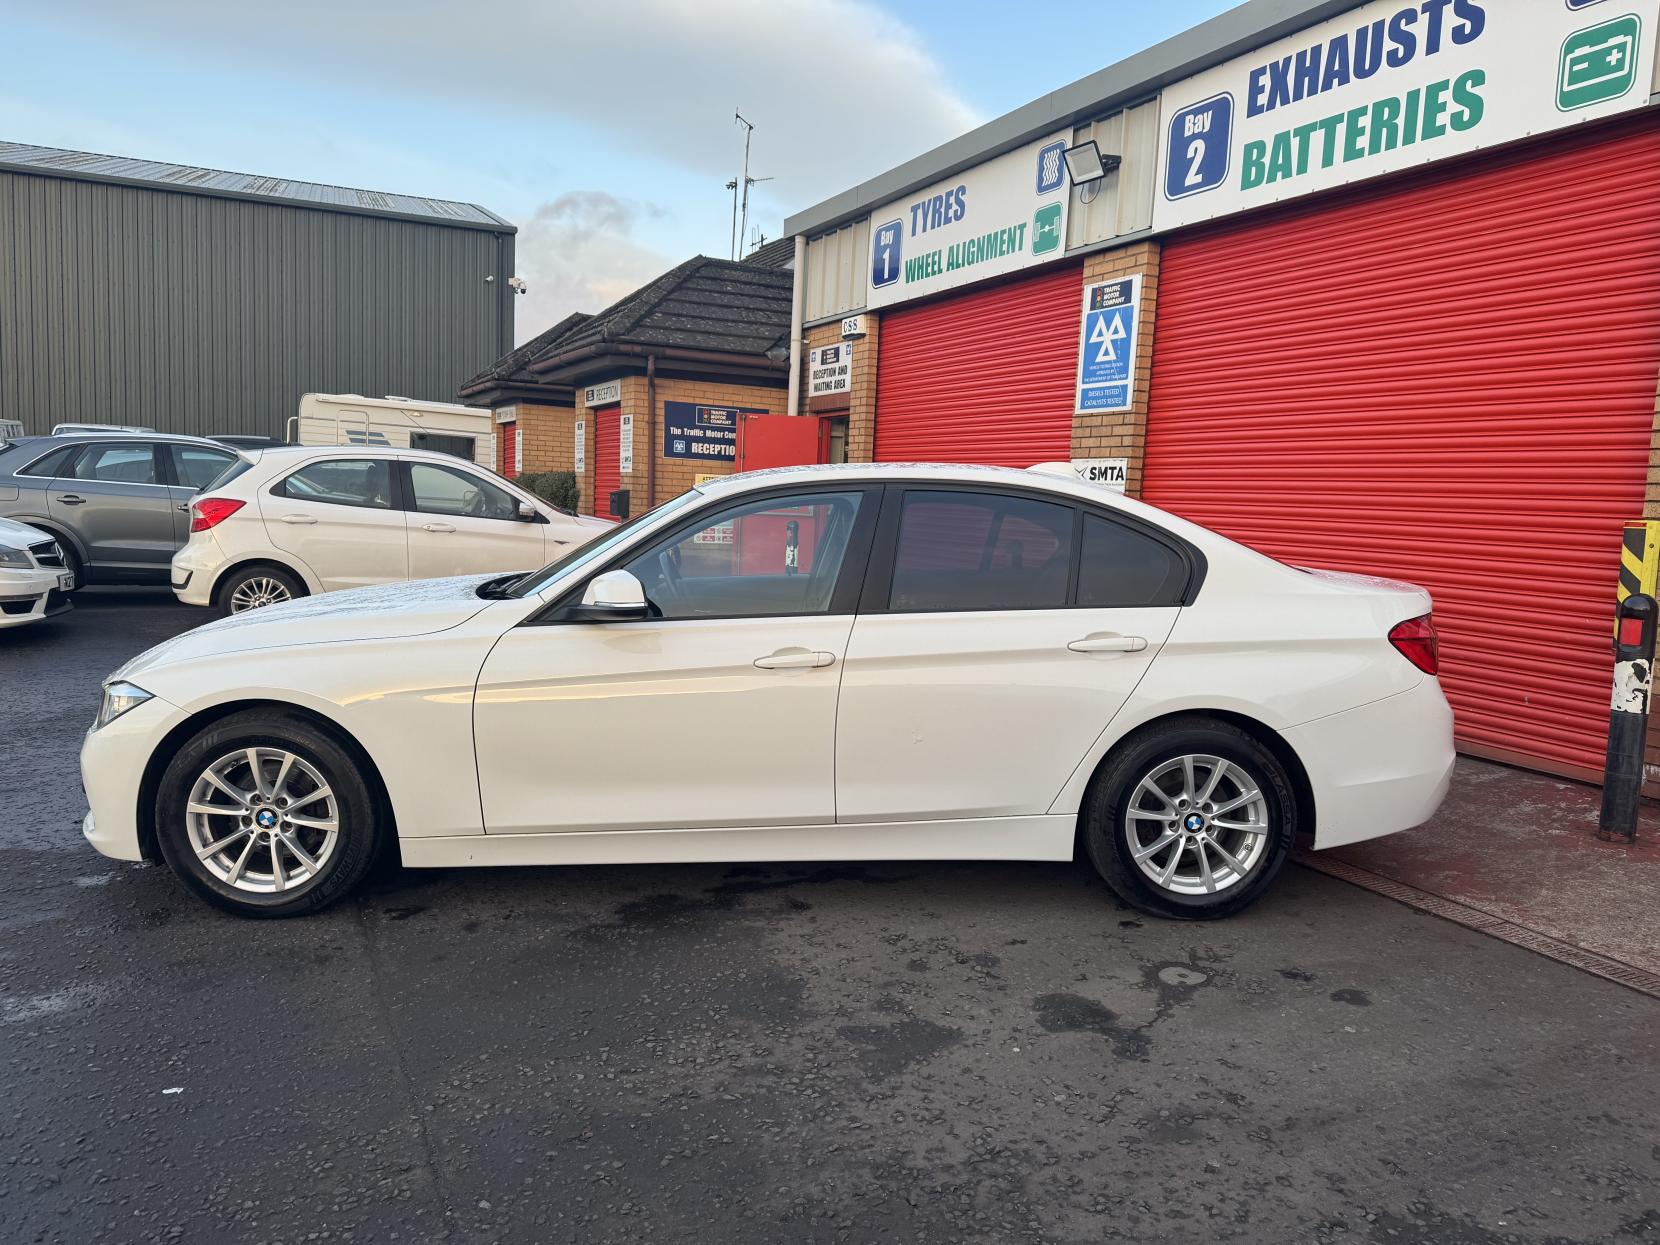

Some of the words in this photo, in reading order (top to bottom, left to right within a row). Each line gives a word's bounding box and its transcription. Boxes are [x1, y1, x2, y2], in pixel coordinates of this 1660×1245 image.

[1247, 0, 1486, 118] EXHAUSTS
[1184, 112, 1212, 137] Bay
[1240, 68, 1486, 191] BATTERIES
[1184, 139, 1205, 188] 2
[910, 184, 967, 237] TYRES
[880, 229, 894, 246] Bay
[905, 249, 943, 284] WHEEL
[946, 222, 1027, 272] ALIGNMENT
[882, 248, 890, 279] 1
[1104, 285, 1120, 293] TRAFFIC
[1103, 297, 1125, 306] COMPANY
[813, 367, 837, 379] RECEPTION
[838, 365, 848, 376] AND
[813, 381, 833, 392] WAITING
[834, 379, 846, 389] AREA
[670, 427, 682, 435] The
[683, 428, 704, 437] Traffic
[705, 430, 724, 438] Motor
[691, 442, 736, 456] RECEPTIO
[1089, 466, 1124, 481] SMTA
